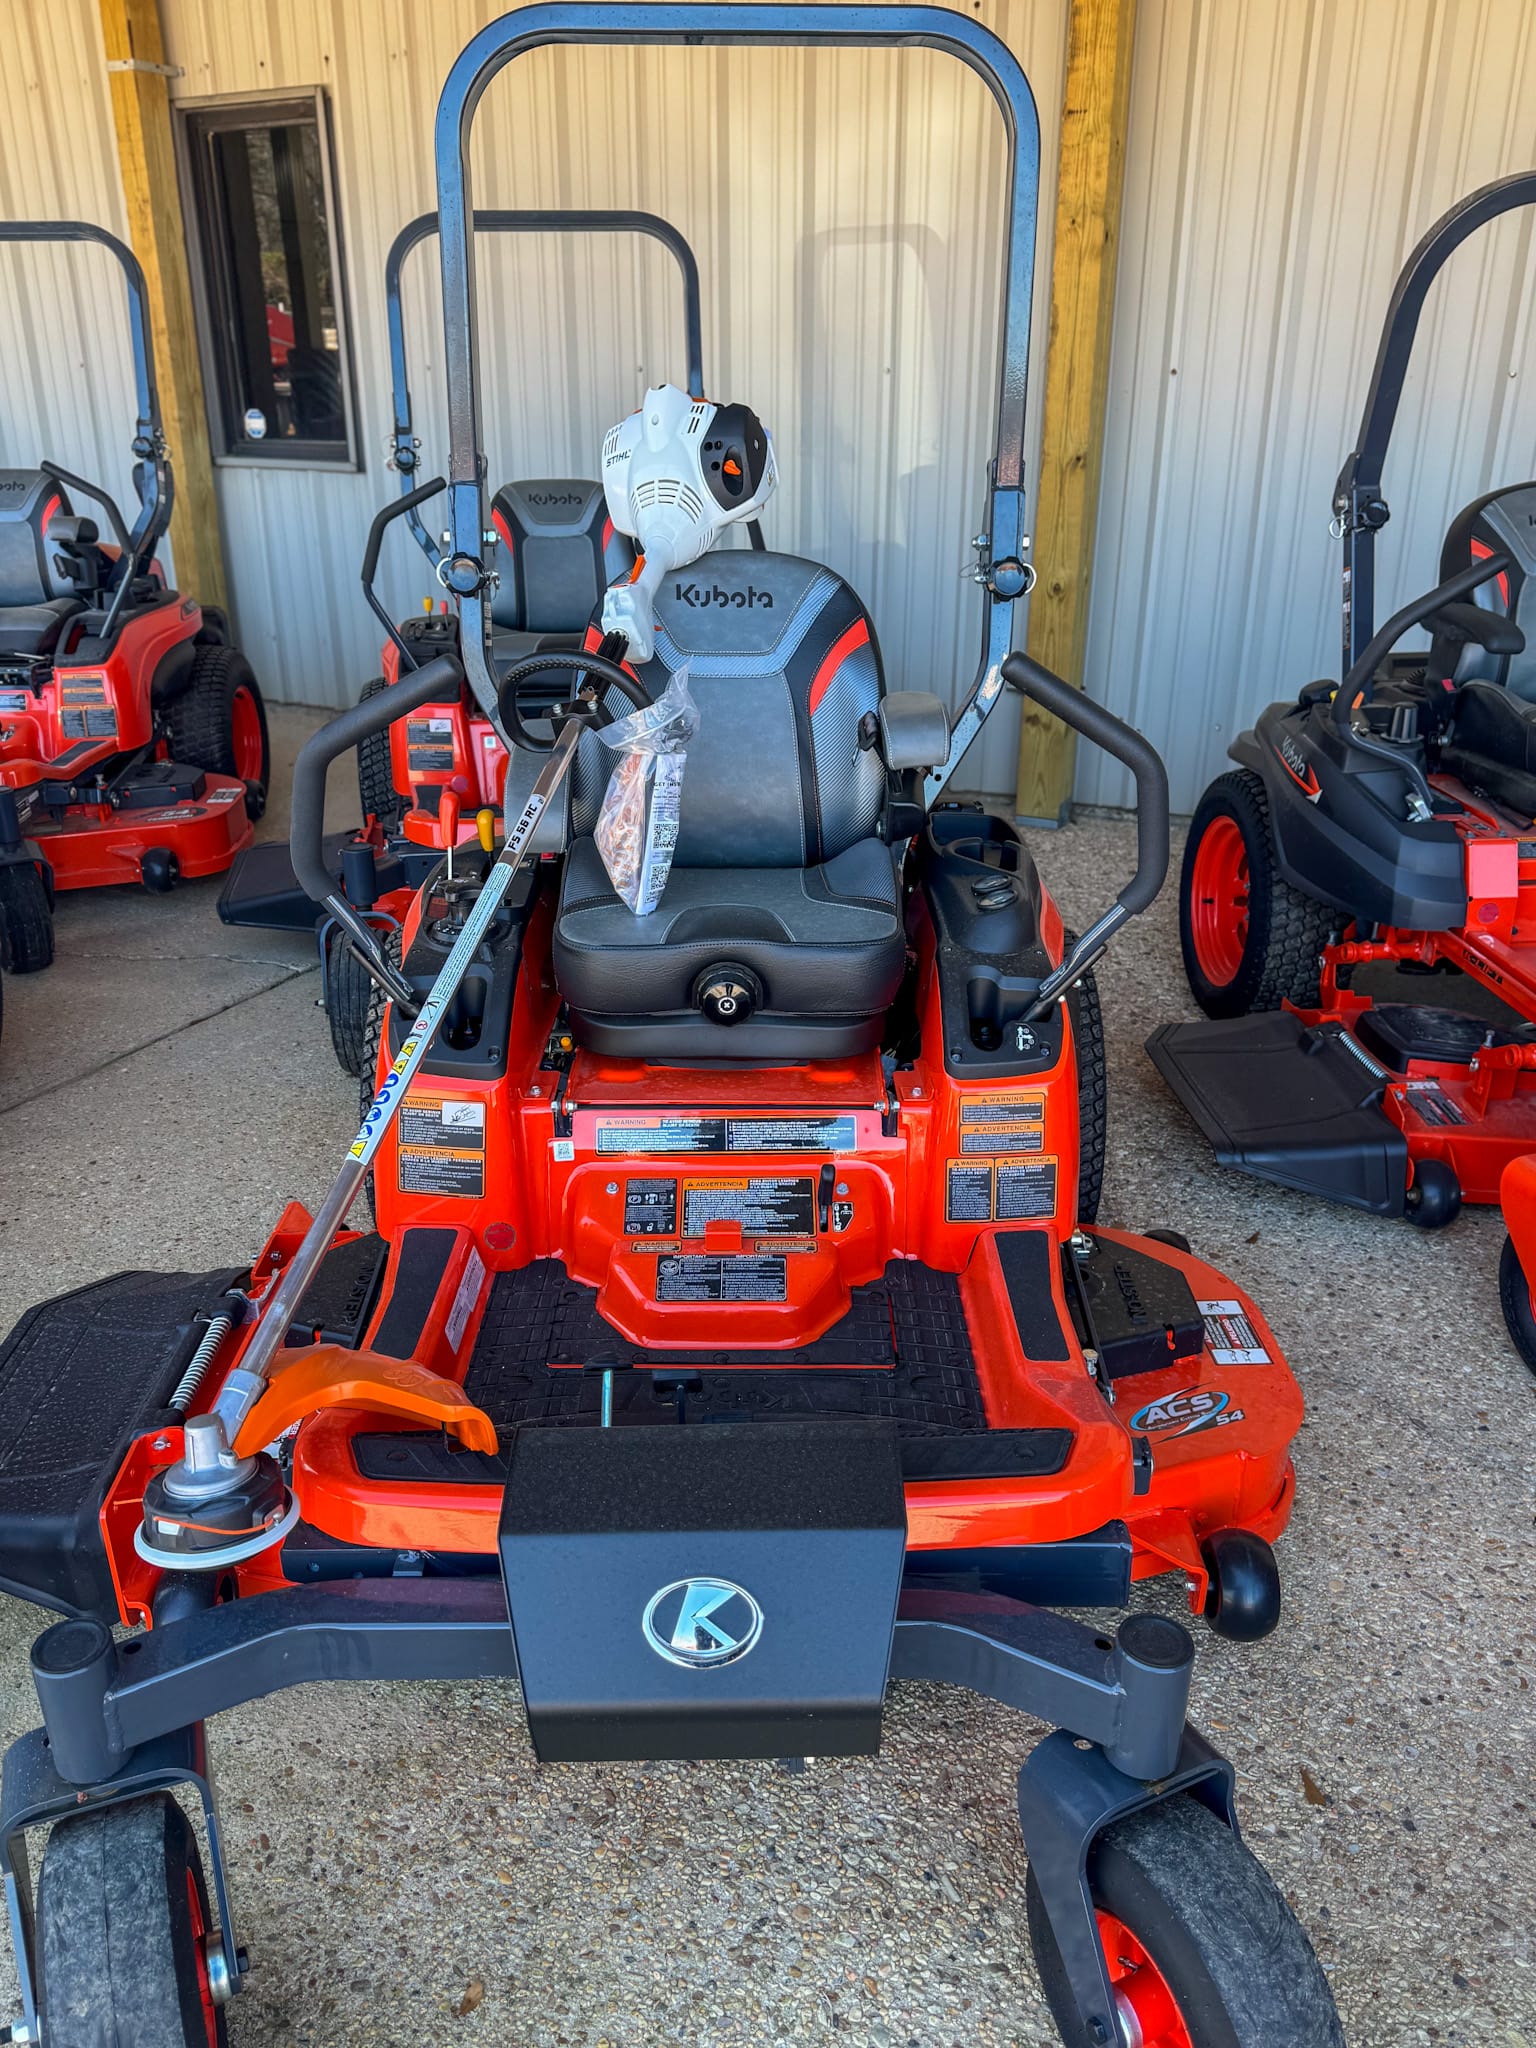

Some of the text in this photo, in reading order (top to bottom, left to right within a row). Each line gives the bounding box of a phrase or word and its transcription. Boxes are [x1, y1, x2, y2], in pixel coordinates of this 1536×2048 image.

[606, 451, 630, 468] STIHL
[528, 493, 583, 505] Kubota
[676, 583, 774, 609] Kubota
[507, 803, 538, 851] FS 56 RC
[409, 1100, 440, 1108] WARNING
[989, 1095, 1024, 1103] WARNING
[982, 1125, 1031, 1133] ADVERTENCIA
[410, 1149, 455, 1157] ADVERTENCIA
[1145, 1392, 1214, 1425] ACS
[1216, 1409, 1244, 1426] 54
